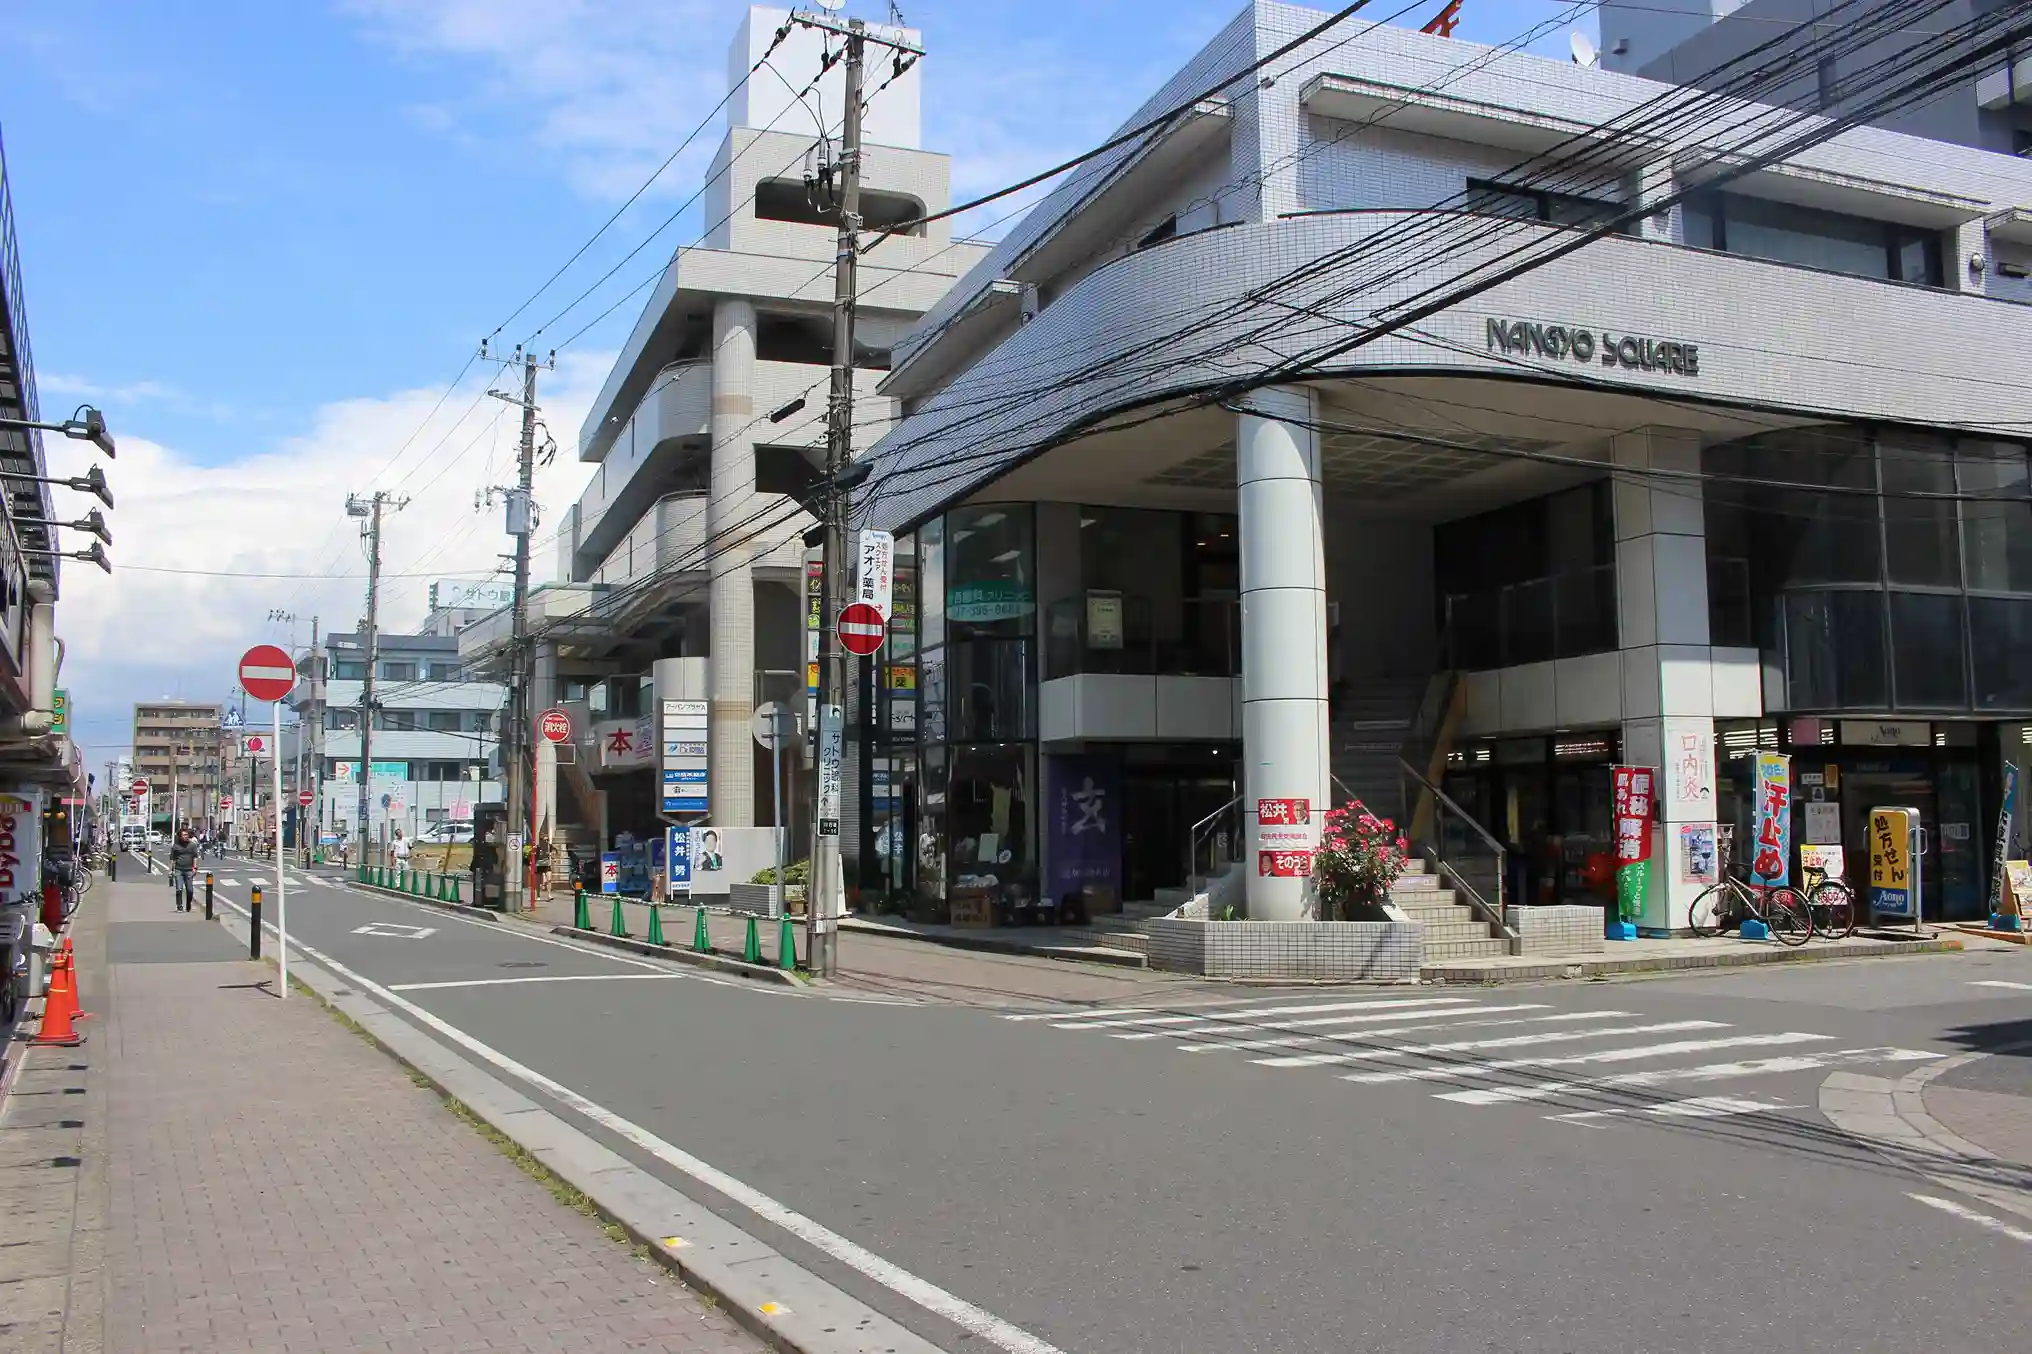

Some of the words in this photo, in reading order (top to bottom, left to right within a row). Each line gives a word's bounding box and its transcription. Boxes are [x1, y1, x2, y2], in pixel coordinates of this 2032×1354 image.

[1602, 333, 1699, 377] SQUARE
[862, 544, 875, 600] アオノ薬局
[465, 588, 515, 603] サトウ眼
[544, 721, 567, 733] 消火栓
[607, 727, 633, 757] 本
[823, 747, 831, 794] クリニック
[1681, 735, 1700, 800] 口内炎
[1070, 775, 1107, 836] 玄
[1260, 802, 1287, 818] 松井
[1754, 780, 1788, 881] 汗止め
[1874, 815, 1904, 883] 処方せん
[605, 863, 619, 877] 本
[1873, 854, 1883, 881] 受付
[1872, 889, 1905, 906] Aono
